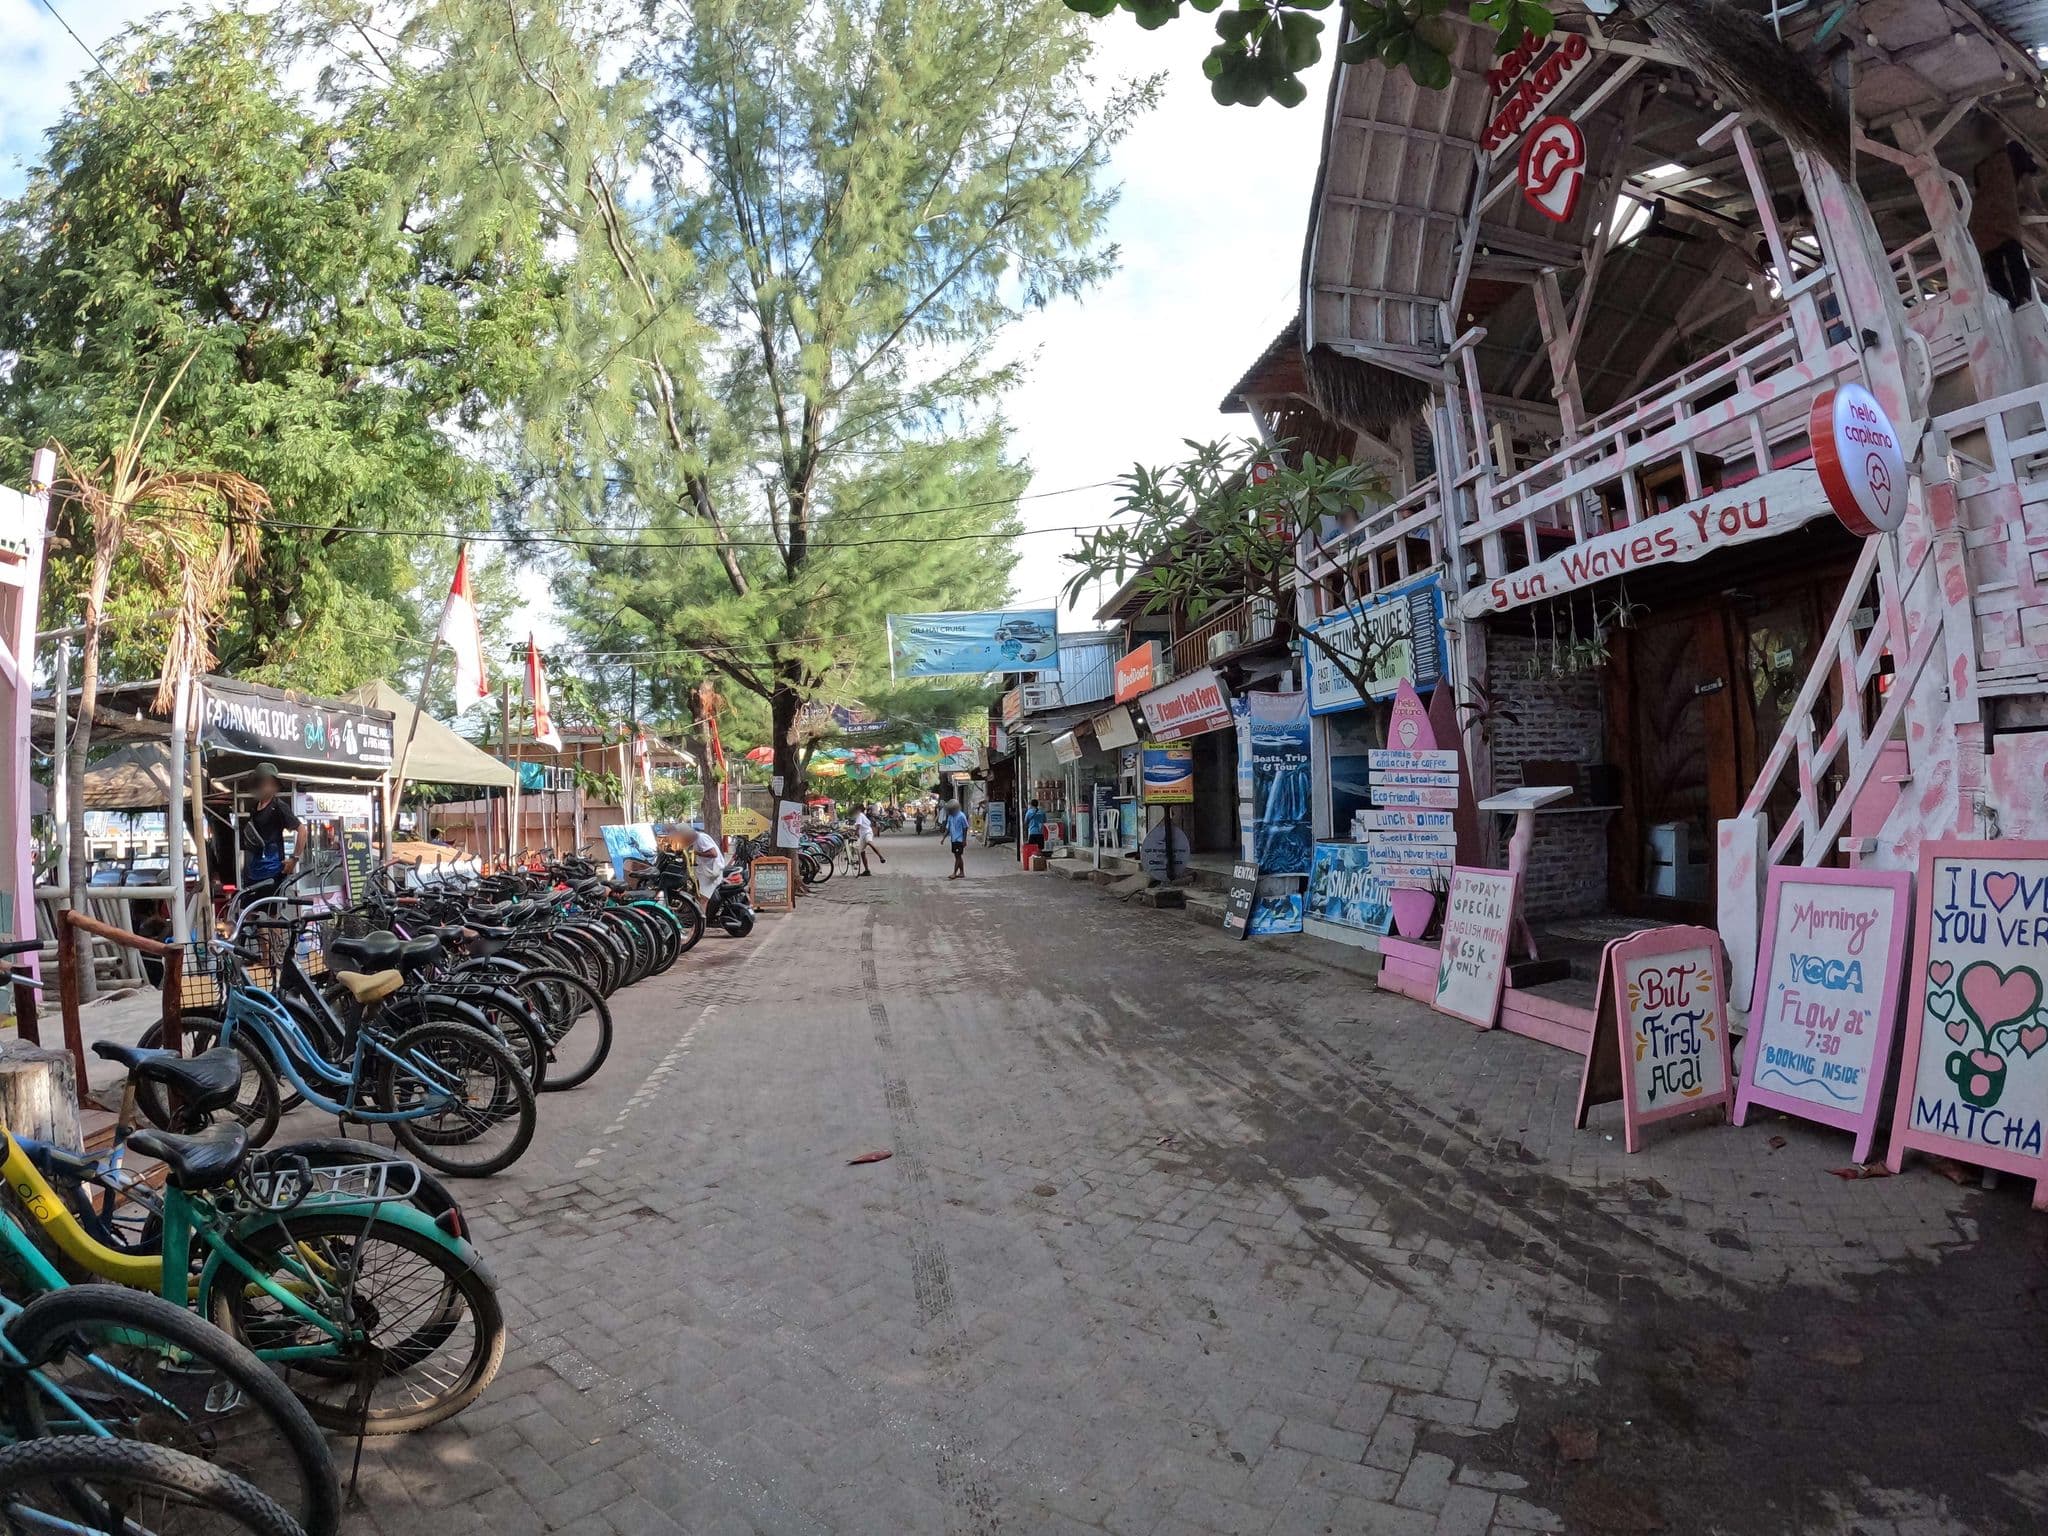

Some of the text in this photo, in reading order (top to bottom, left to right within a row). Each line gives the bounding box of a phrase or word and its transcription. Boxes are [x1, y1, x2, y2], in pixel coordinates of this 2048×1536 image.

[1481, 33, 1588, 151] capitano
[1848, 399, 1877, 424] hello
[1845, 425, 1893, 449] capitano
[1688, 496, 1769, 543] You
[940, 624, 968, 633] CRUISE
[1361, 608, 1404, 644] SERVICE
[1318, 667, 1328, 680] FAST
[1380, 663, 1396, 679] TOUR
[1319, 681, 1330, 694] BOAT
[1180, 690, 1200, 714] Fast
[1195, 684, 1220, 709] Ferry
[1398, 699, 1417, 708] hello
[205, 697, 300, 742] FAJAR PAGI BIKE
[1253, 753, 1308, 763] Boats, Trip
[1263, 762, 1297, 772] & Tour
[1376, 759, 1389, 768] and
[1396, 759, 1410, 769] cup
[1411, 759, 1419, 769] of
[1421, 759, 1448, 769] coffee
[1381, 773, 1451, 786] All day breakfast
[1373, 790, 1388, 802] Eco
[1389, 789, 1420, 806] friendly
[1376, 812, 1451, 826] Lunch & Dinner
[1379, 833, 1407, 842] Sweets
[1407, 833, 1414, 842] &
[1370, 844, 1401, 862] Healthy
[1233, 865, 1256, 882] RENTAL
[1945, 866, 1962, 910] I
[1447, 920, 1482, 939] ENGLISH
[1933, 908, 1987, 944] YOU
[1461, 940, 1475, 958] 65
[1456, 962, 1481, 979] ONLY
[1789, 952, 1864, 994] YOGA
[1638, 961, 1697, 1011] But
[1642, 1008, 1705, 1060] First
[1805, 1029, 1841, 1056] 7:30
[1647, 1055, 1703, 1104] Acai
[1916, 1095, 2041, 1155] MATCHA
